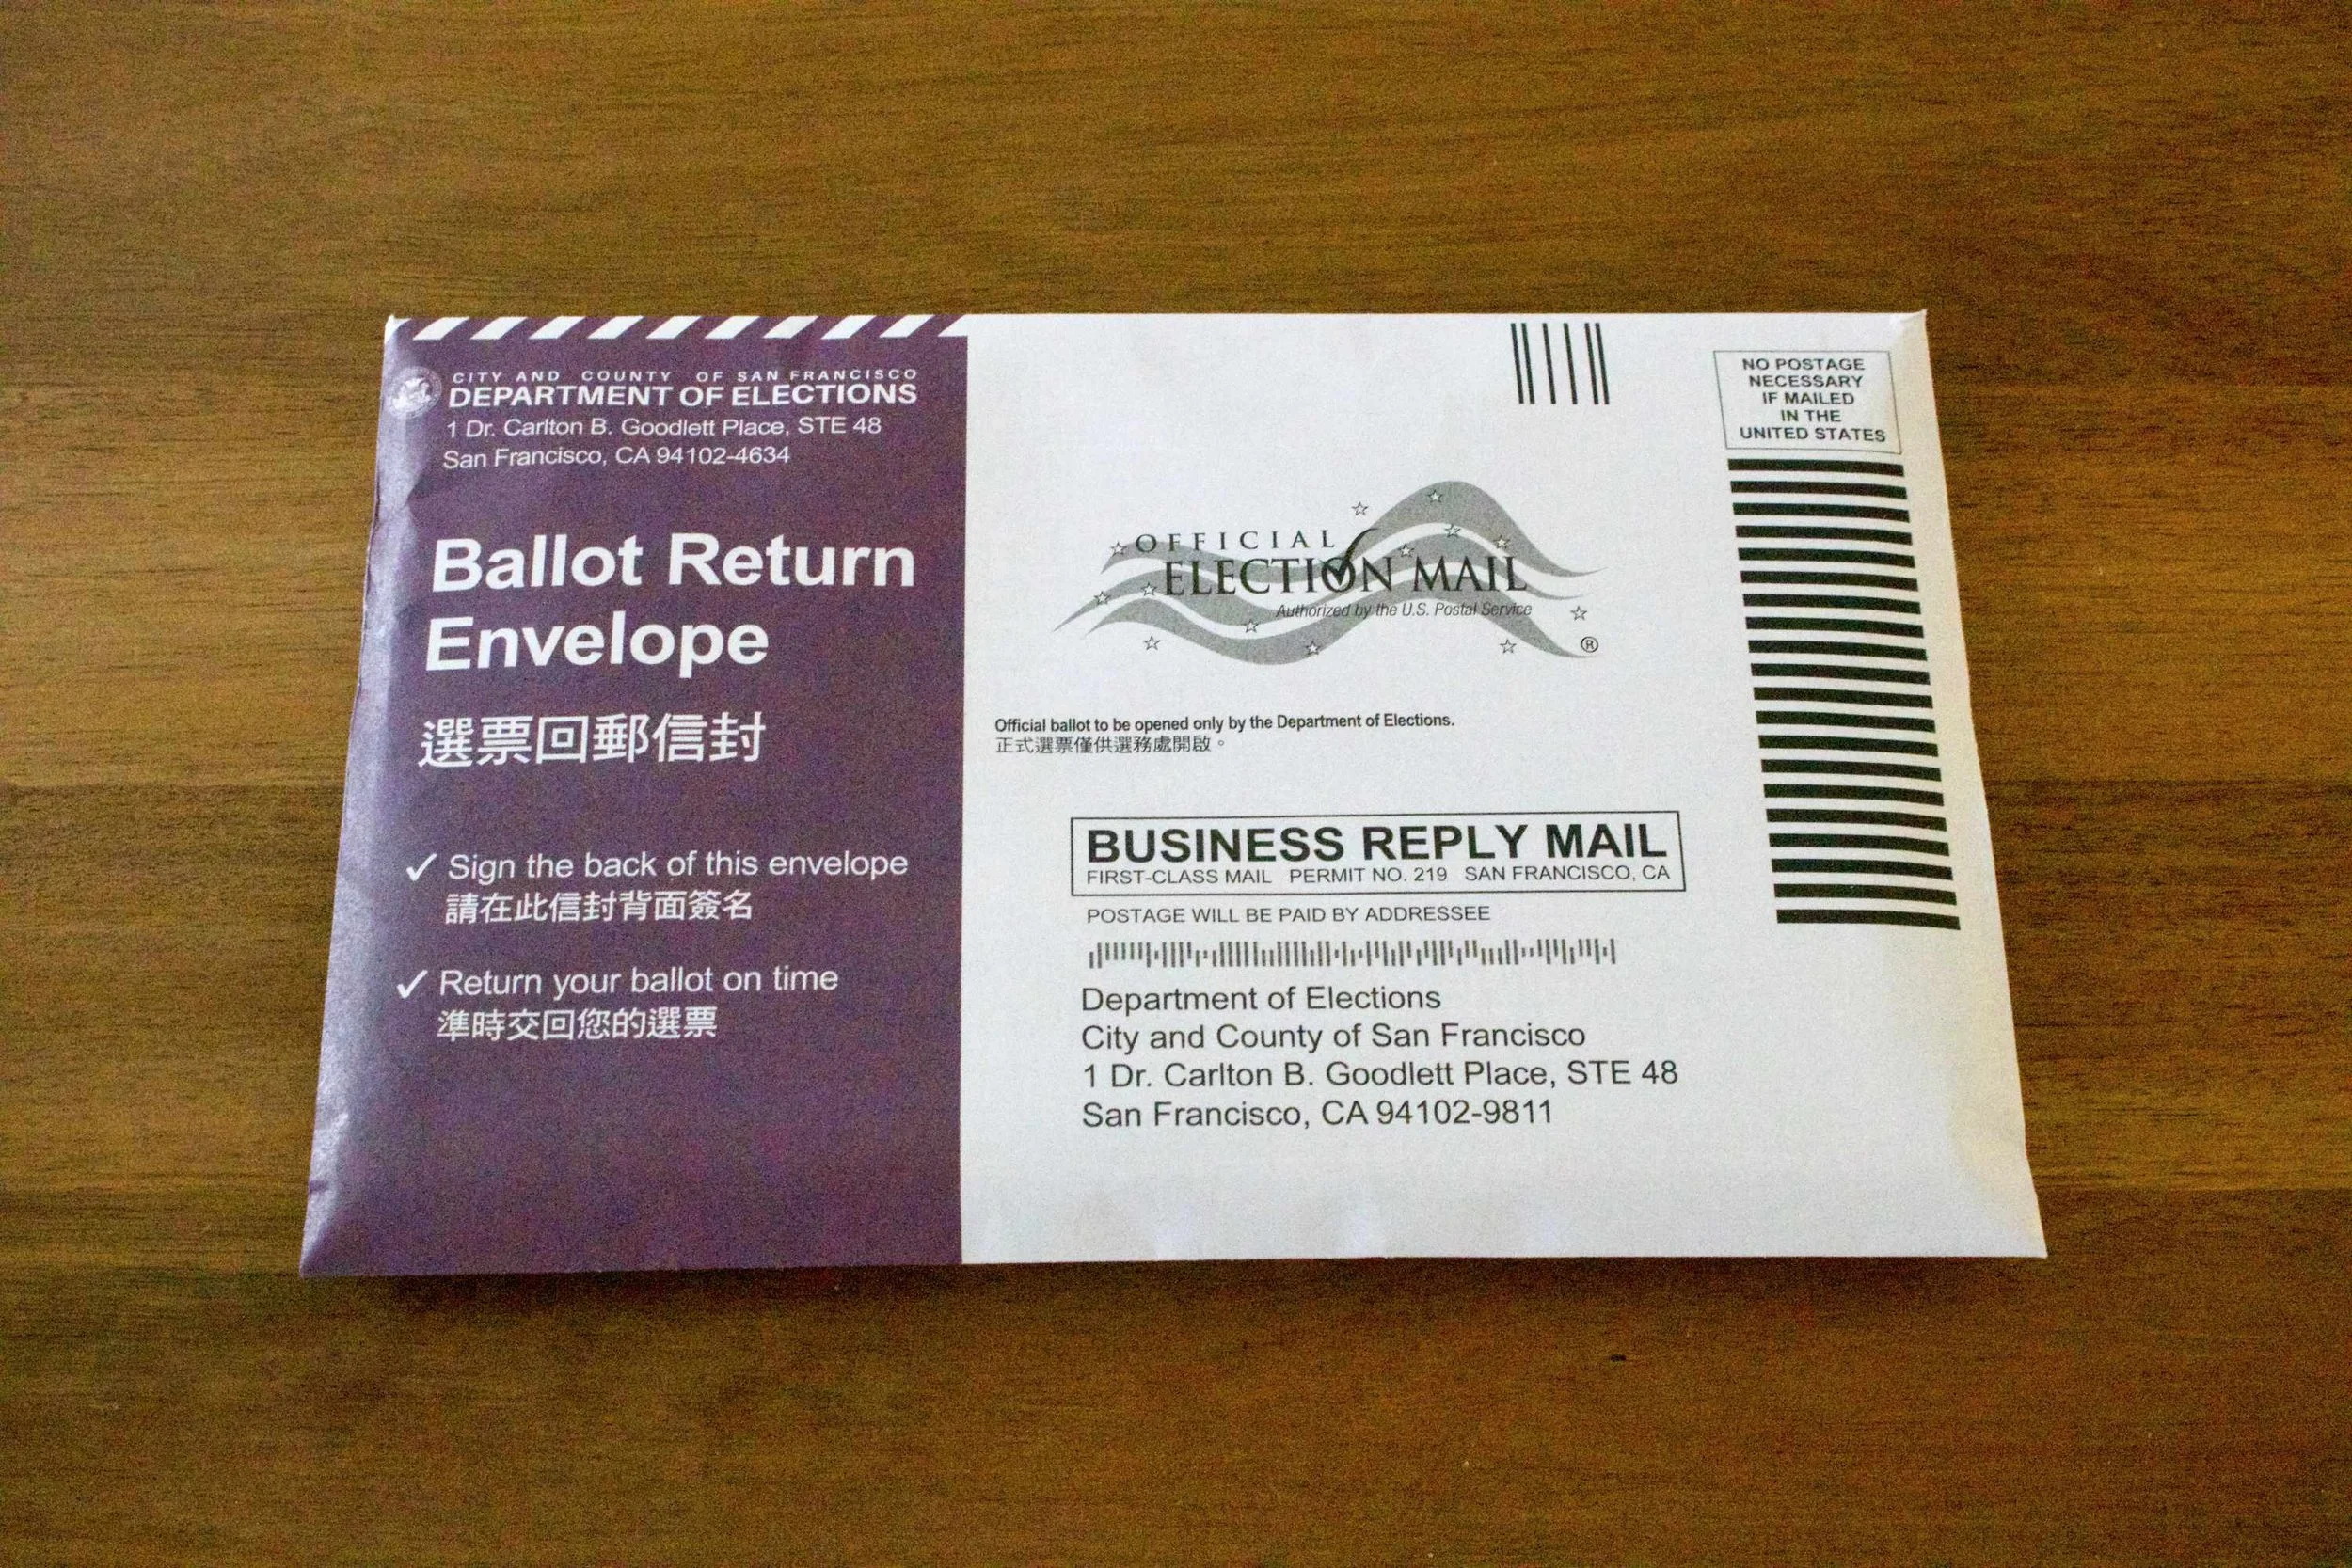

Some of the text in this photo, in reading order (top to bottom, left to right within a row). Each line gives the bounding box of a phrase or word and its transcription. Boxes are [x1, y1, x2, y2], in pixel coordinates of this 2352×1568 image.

[453, 369, 916, 383] CITY AND COUNTY OF SAN FRANCISCO
[1742, 358, 1864, 370] NO POSTAGE
[1750, 375, 1862, 387] NECESSARY
[449, 386, 673, 407] DEPARTMENT
[680, 387, 723, 406] OF
[732, 384, 916, 406] ELECTIONS
[1763, 392, 1854, 404] IF MAILED
[448, 416, 882, 437] 1 Dr. Carlton B. Goodlett Place, STE 48
[1782, 410, 1840, 421] IN THE
[1740, 427, 1885, 442] UNITED STATES
[443, 446, 789, 469] San Francisco, CA 94102-4634
[1134, 529, 1336, 553] OFFICIAL
[433, 533, 914, 592] Ballot Return
[1163, 553, 1526, 596] ELECTION MAIL
[1275, 602, 1533, 620] Authorized by the U.S. Postal Service
[426, 610, 768, 678] Envelope
[995, 713, 1454, 734] Official ballot to be opened only by the Department of Elections.
[418, 712, 766, 768] 選票回郵信封
[1089, 824, 1666, 863] BUSINESS REPLY MAIL
[449, 850, 908, 885] Sign the back of this envelope
[1088, 865, 1670, 884] FIRST-CLASS MAIL PERMIT NO. 219 SAN FRANCISCO, CA
[446, 890, 752, 924] 請在此信封背面簽名
[1088, 906, 1489, 923] POSTAGE WILL BE PAID BY ADDRESSEE
[440, 965, 838, 1001] Return your ballot on time
[1083, 986, 1440, 1016] Department of Elections
[437, 1006, 717, 1041] 準時交回您的選票
[1082, 1023, 1585, 1055] City and County of San Francisco
[1085, 1060, 1677, 1088] 1 Dr. Carlton B. Goodlett Place, STE 48
[1083, 1100, 1549, 1129] San Francisco, CA 94102-9811
